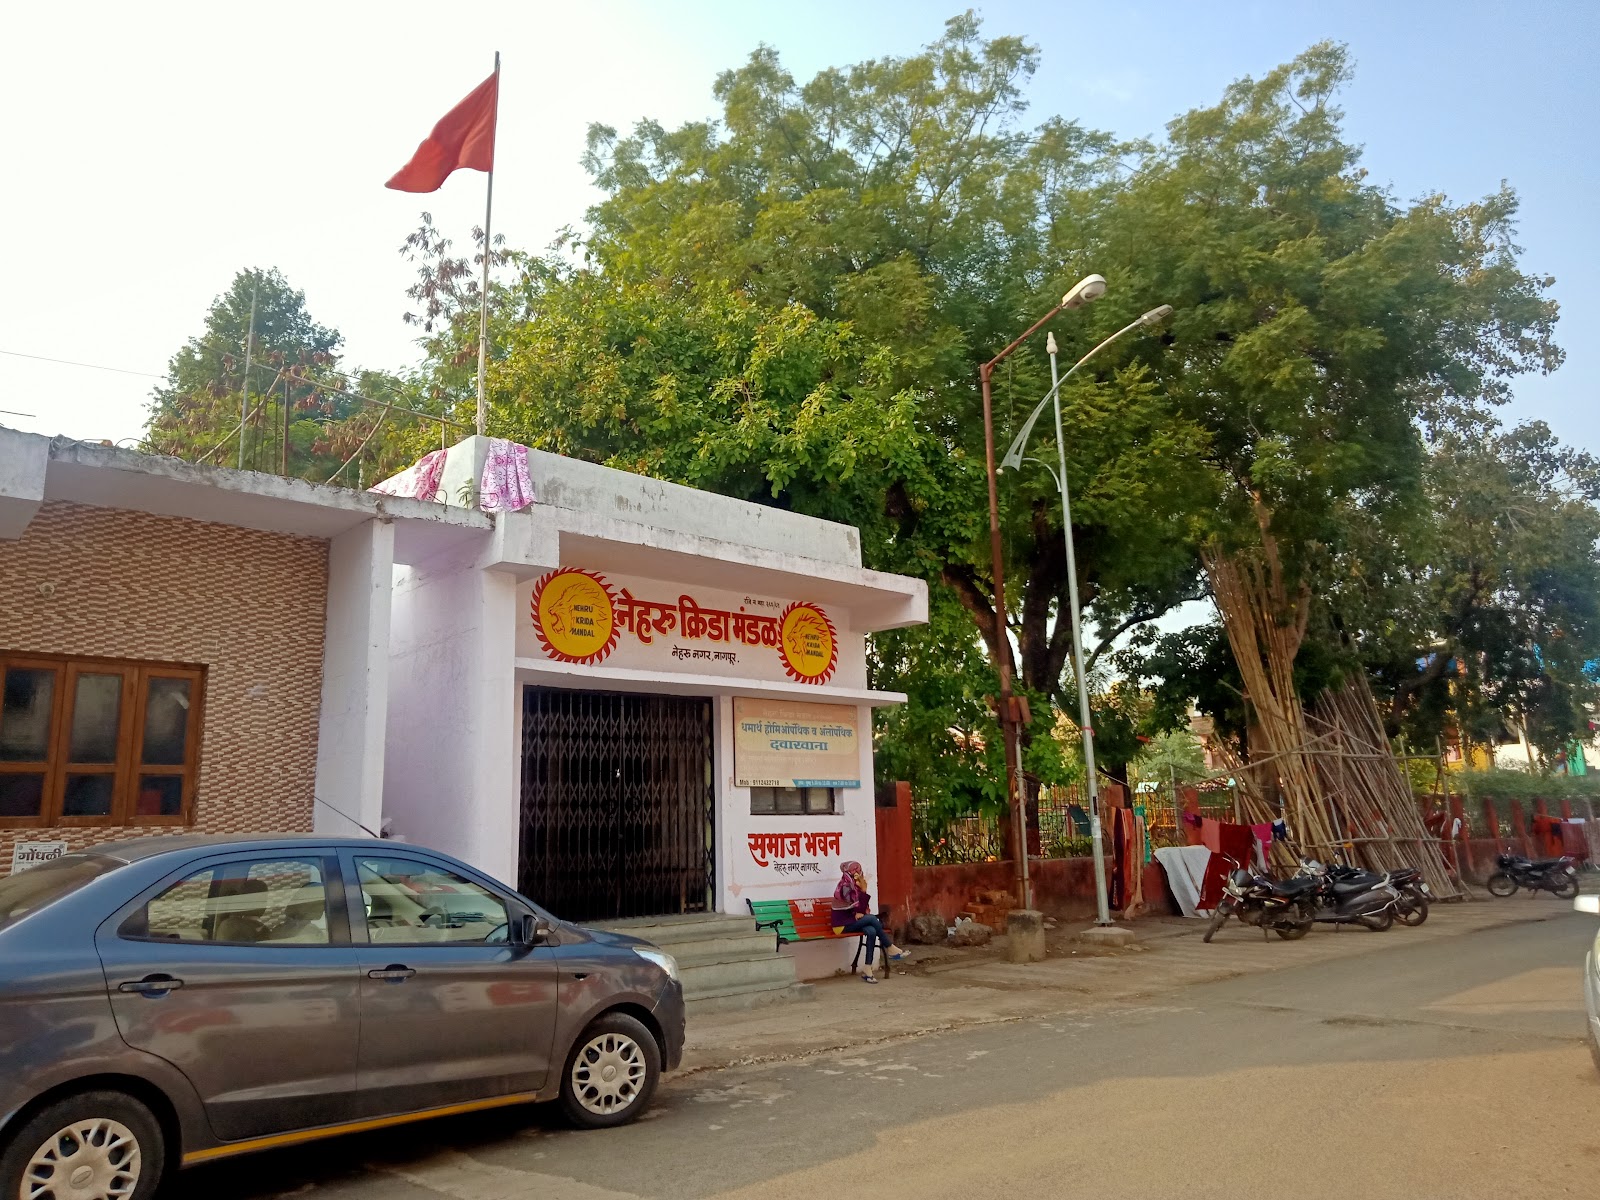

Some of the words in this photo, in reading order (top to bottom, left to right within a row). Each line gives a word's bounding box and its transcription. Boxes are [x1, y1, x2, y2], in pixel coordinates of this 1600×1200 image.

[573, 604, 594, 613] NEHRU
[576, 616, 594, 626] KRIDA
[678, 594, 731, 642] क्रिडा
[732, 606, 778, 646] मंडळ
[570, 628, 595, 637] MANDAL
[805, 633, 820, 641] NEHRU
[805, 649, 824, 658] MANDAL
[770, 739, 829, 751] दवाखाना
[747, 833, 803, 867] समाज
[803, 832, 843, 857] भवन
